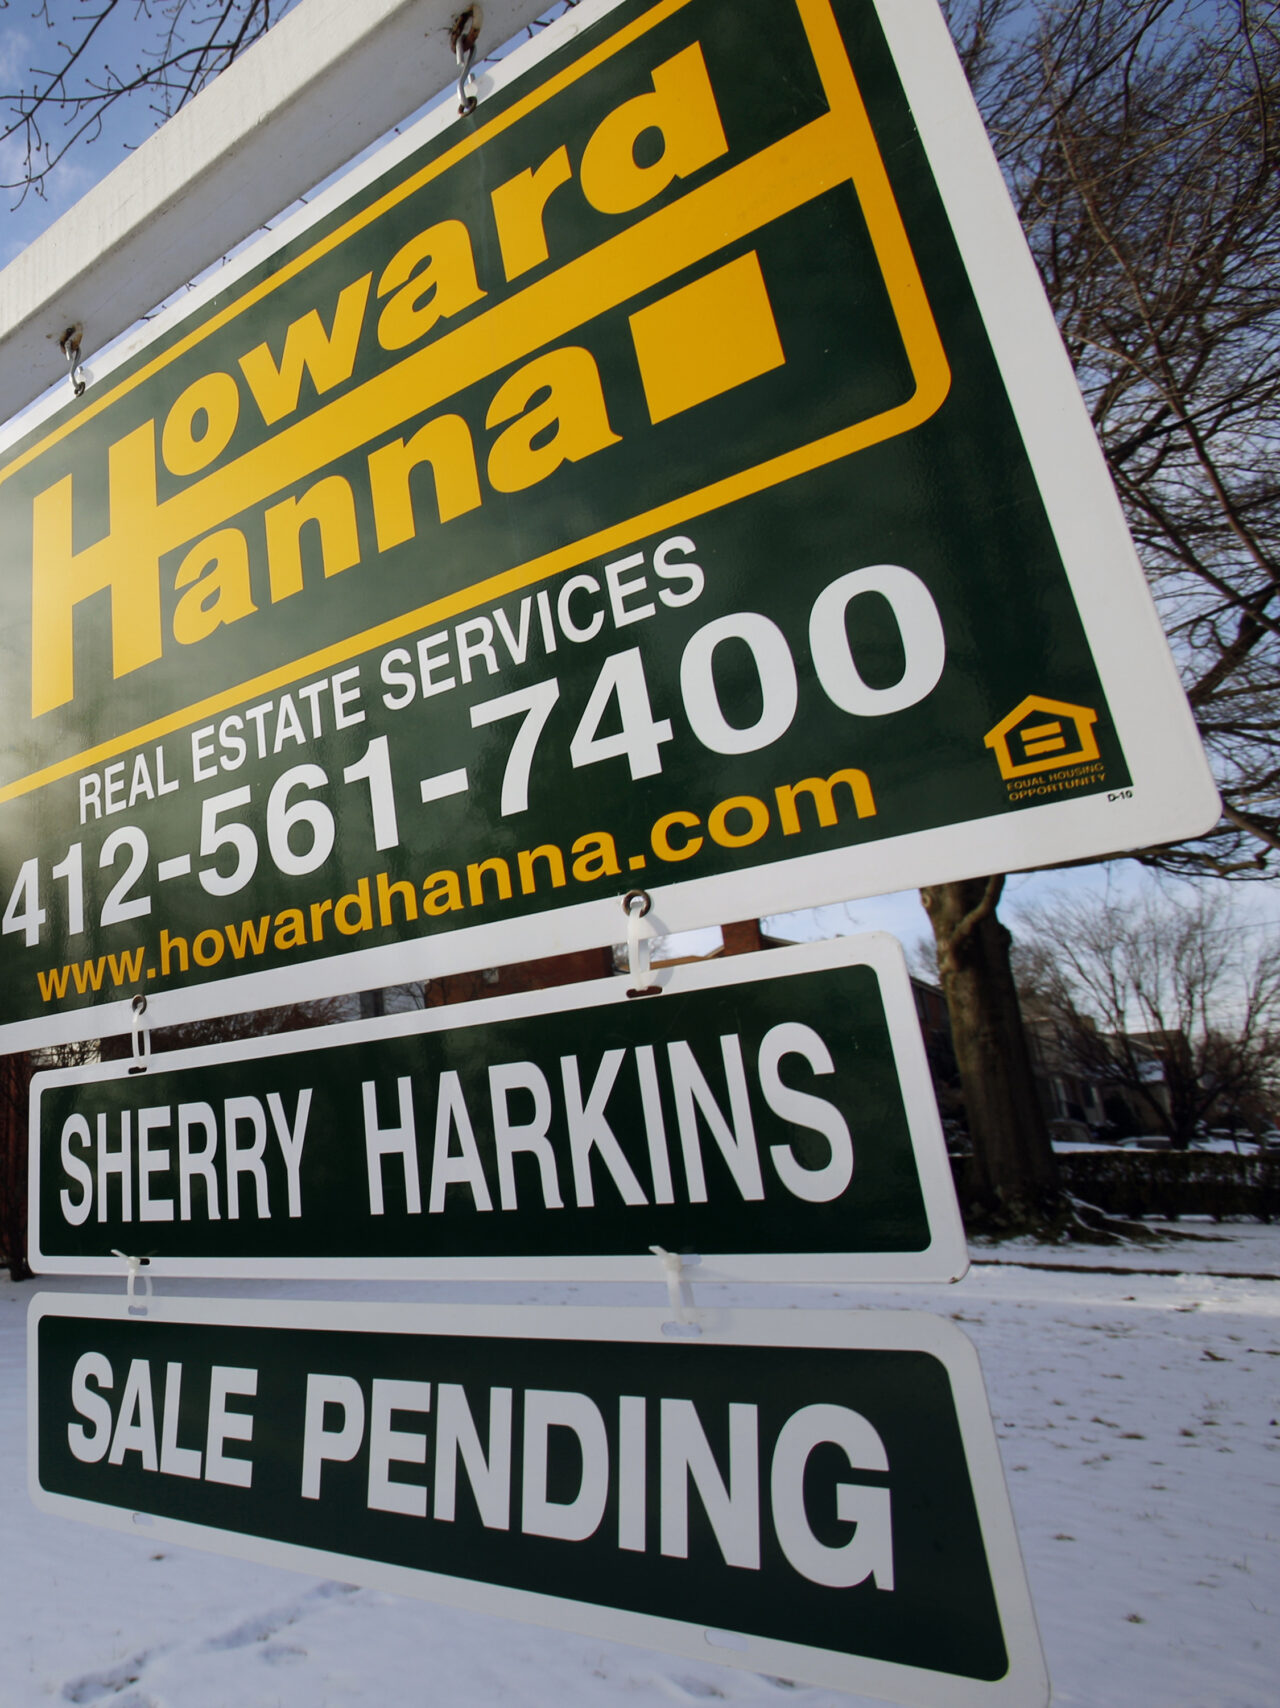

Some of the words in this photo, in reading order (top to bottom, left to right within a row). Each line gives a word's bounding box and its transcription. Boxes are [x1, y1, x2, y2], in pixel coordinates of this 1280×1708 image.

[32, 41, 729, 717] Howard
[32, 346, 623, 717] Hanna
[1, 564, 946, 948] 412-561-7400
[77, 750, 179, 824] REAL
[192, 664, 366, 783] ESTATE
[380, 535, 705, 711] SERVICES
[1006, 775, 1046, 792] EQUAL
[1048, 762, 1105, 782] HOUSING
[1008, 772, 1107, 801] OPPORTUNITY
[36, 768, 877, 1002] www.howardhanna.com
[60, 1088, 313, 1226] SHERRY
[362, 1022, 854, 1215] HARKINS
[67, 1351, 258, 1489] SALE
[301, 1373, 894, 1591] PENDING
